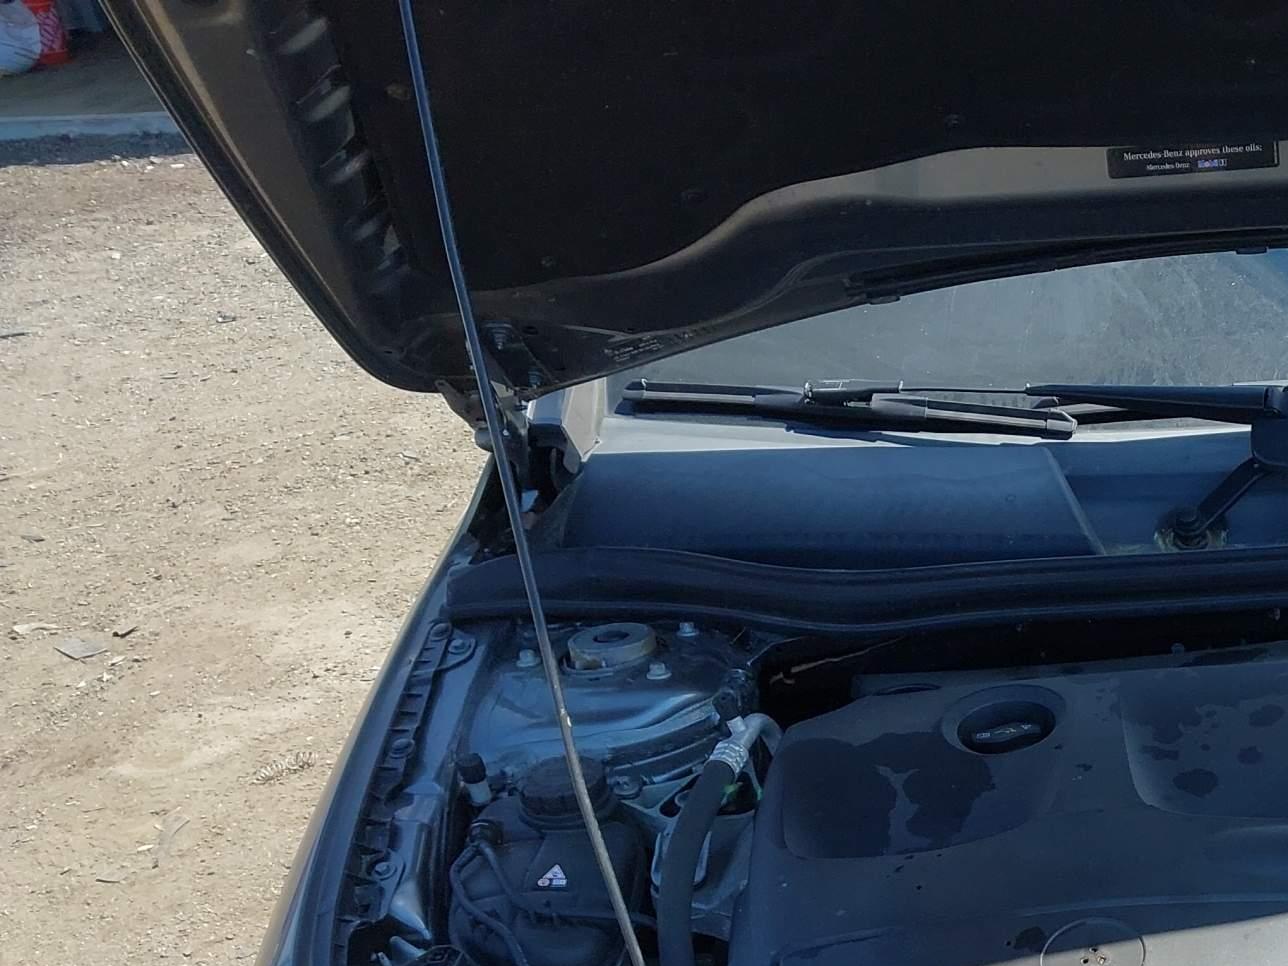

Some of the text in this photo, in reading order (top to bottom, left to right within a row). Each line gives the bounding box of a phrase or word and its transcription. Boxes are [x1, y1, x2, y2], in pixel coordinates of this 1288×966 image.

[1123, 149, 1183, 160] Mercedes-Benz
[1185, 147, 1221, 158] approves
[1222, 145, 1243, 153] these
